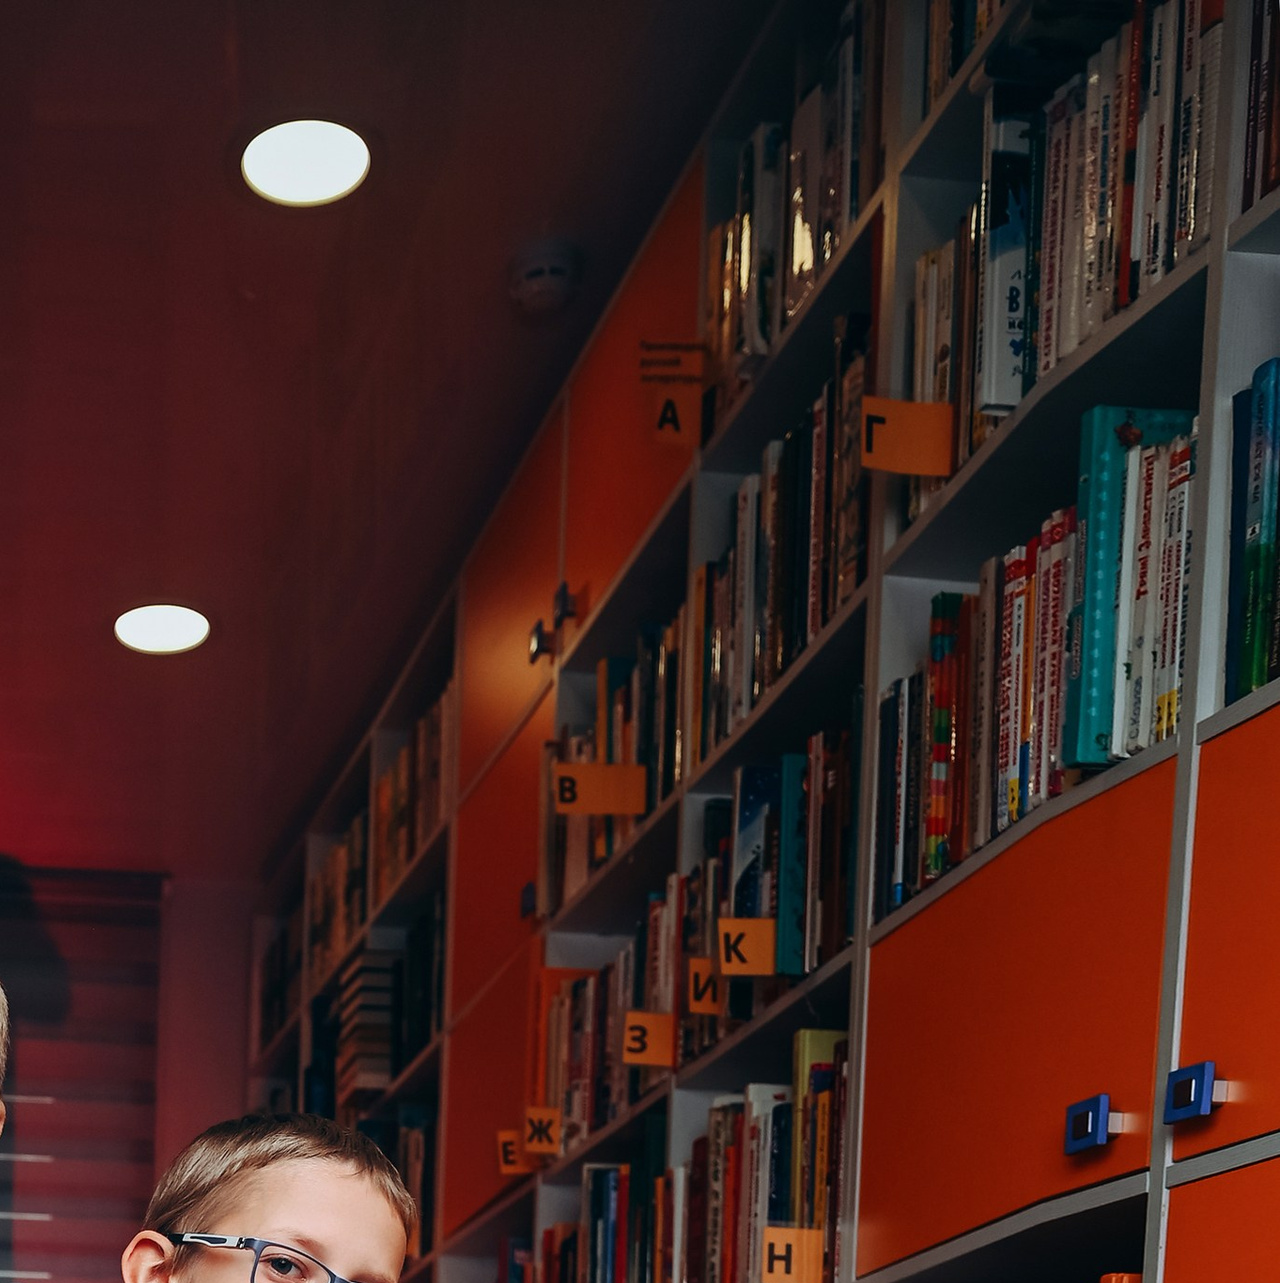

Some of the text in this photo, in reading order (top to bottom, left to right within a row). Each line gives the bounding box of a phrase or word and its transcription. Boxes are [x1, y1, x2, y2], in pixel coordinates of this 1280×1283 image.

[658, 398, 681, 432] А
[866, 414, 887, 453] Г
[559, 776, 578, 804] В
[723, 930, 747, 965] К
[692, 972, 719, 1003] И
[526, 1117, 554, 1144] Ж
[503, 1144, 517, 1166] Е
[766, 1242, 793, 1276] Н
